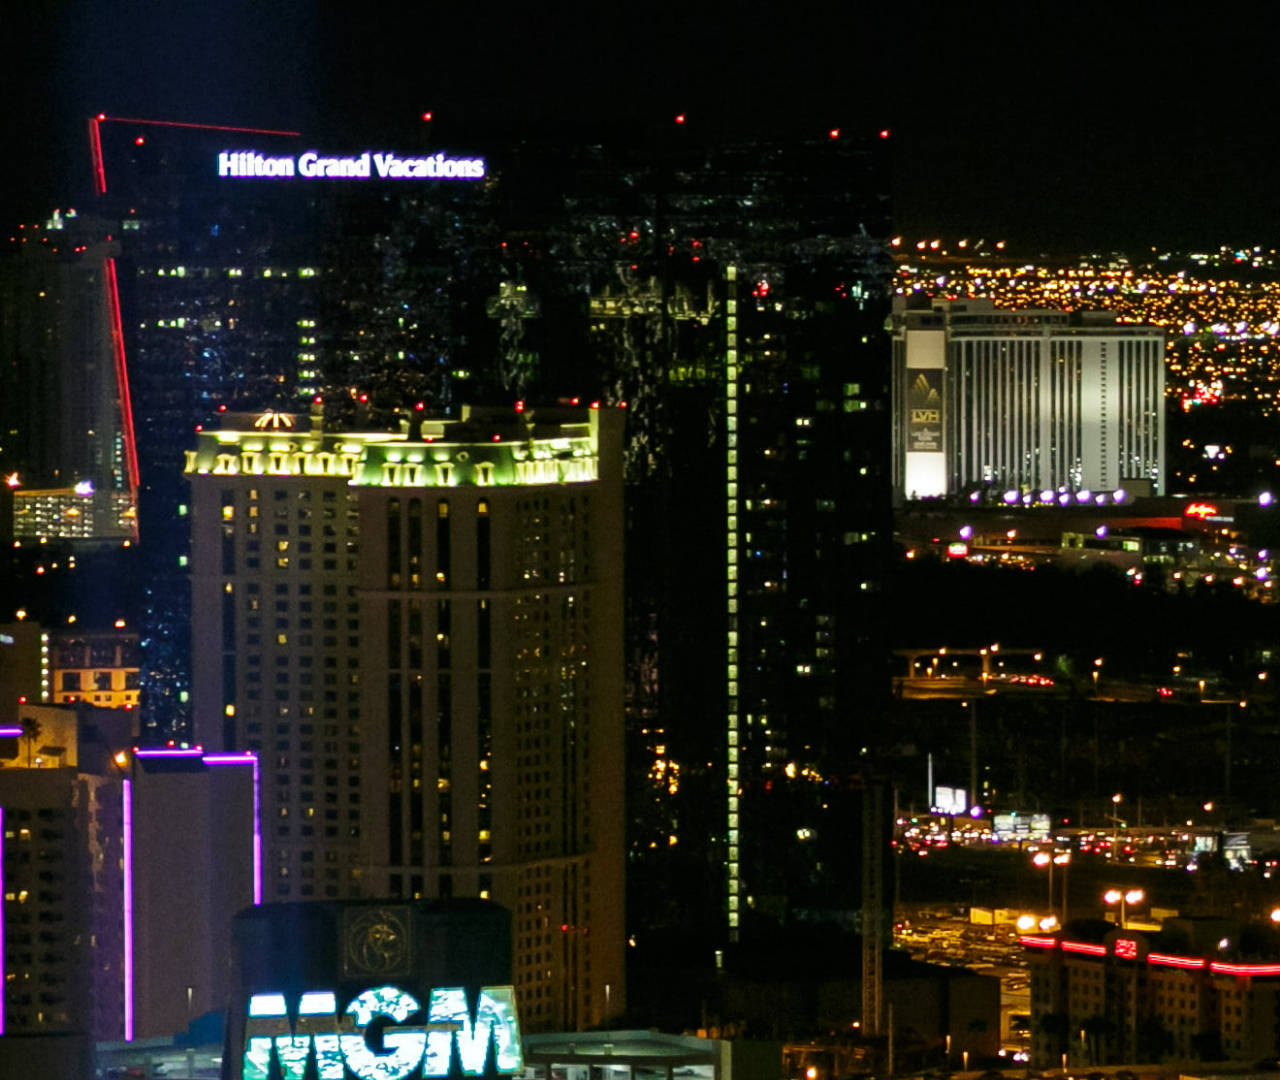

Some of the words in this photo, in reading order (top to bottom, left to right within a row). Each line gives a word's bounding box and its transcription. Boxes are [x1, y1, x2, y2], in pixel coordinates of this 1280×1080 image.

[218, 152, 294, 177] Hilton
[299, 152, 371, 178] Grand
[373, 153, 485, 178] Vacations
